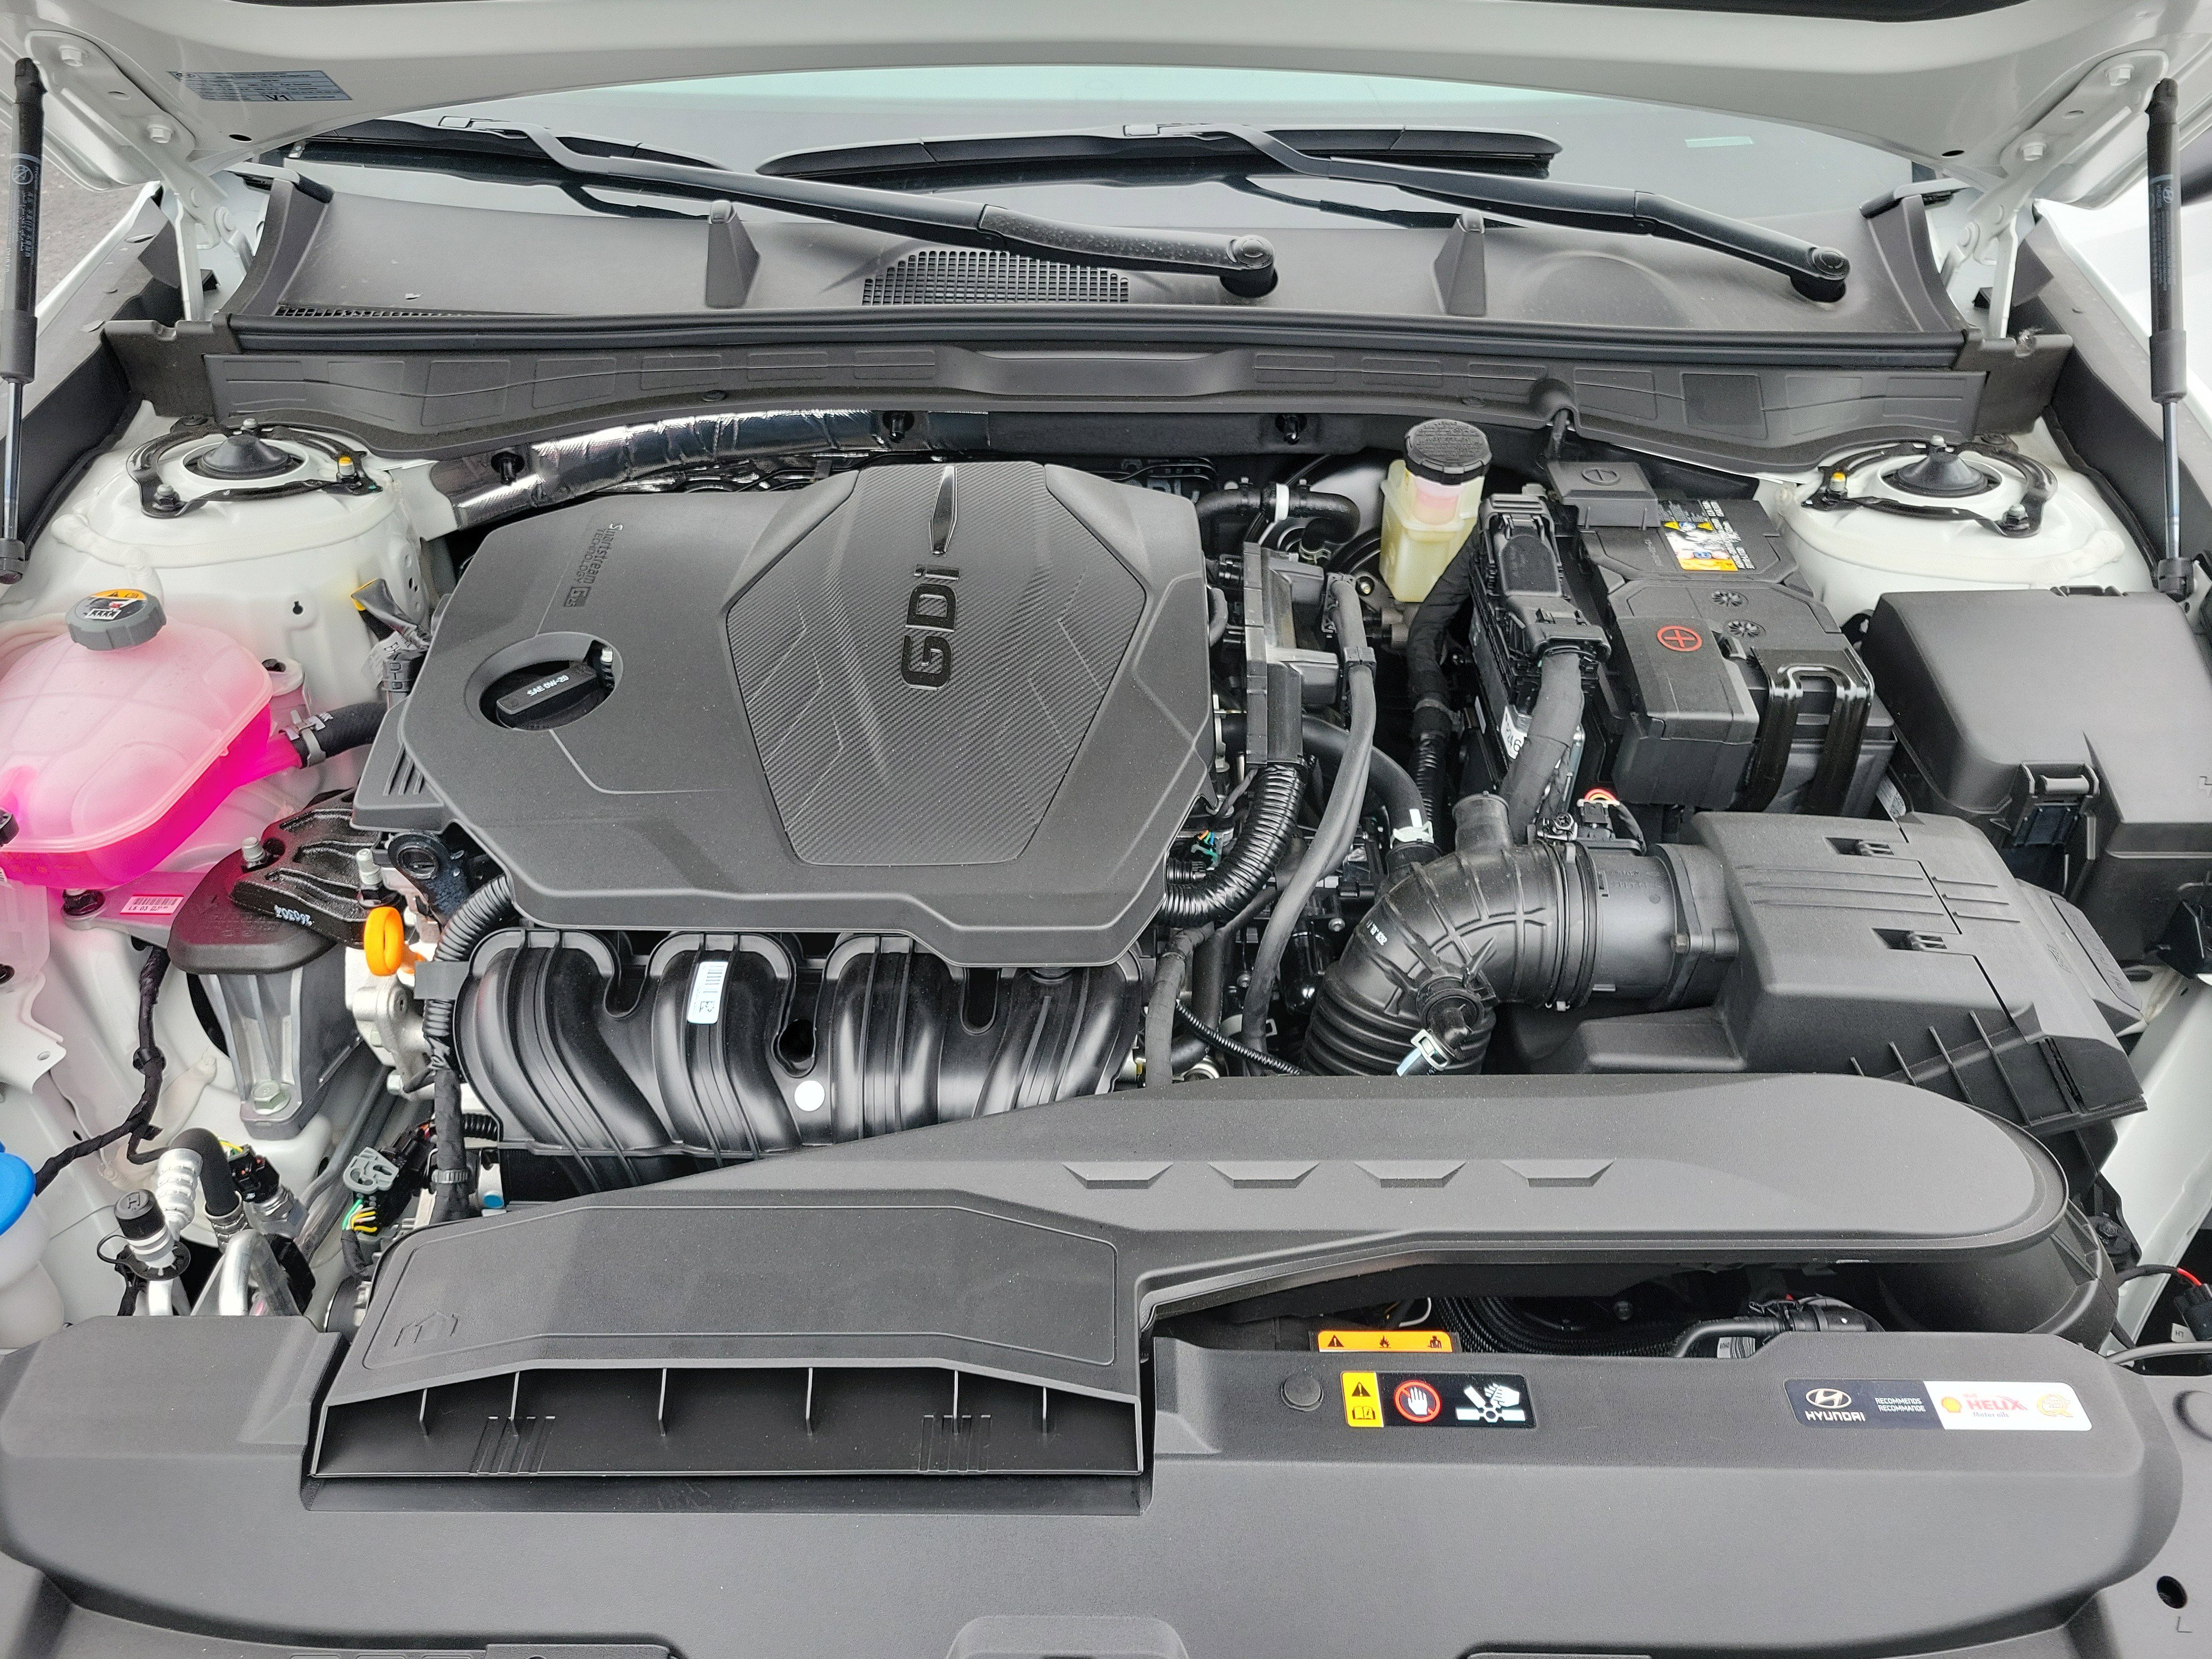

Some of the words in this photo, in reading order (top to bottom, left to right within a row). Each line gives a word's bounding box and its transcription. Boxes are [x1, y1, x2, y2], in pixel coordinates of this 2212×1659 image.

[575, 529, 606, 585] TECHNOLOGY
[584, 523, 623, 584] Smartstream
[900, 563, 961, 692] GDi
[527, 685, 545, 696] SAE
[543, 674, 569, 689] 0W-20
[1805, 1410, 1866, 1421] HYUNDAI
[1966, 1400, 2026, 1410] HELIX
